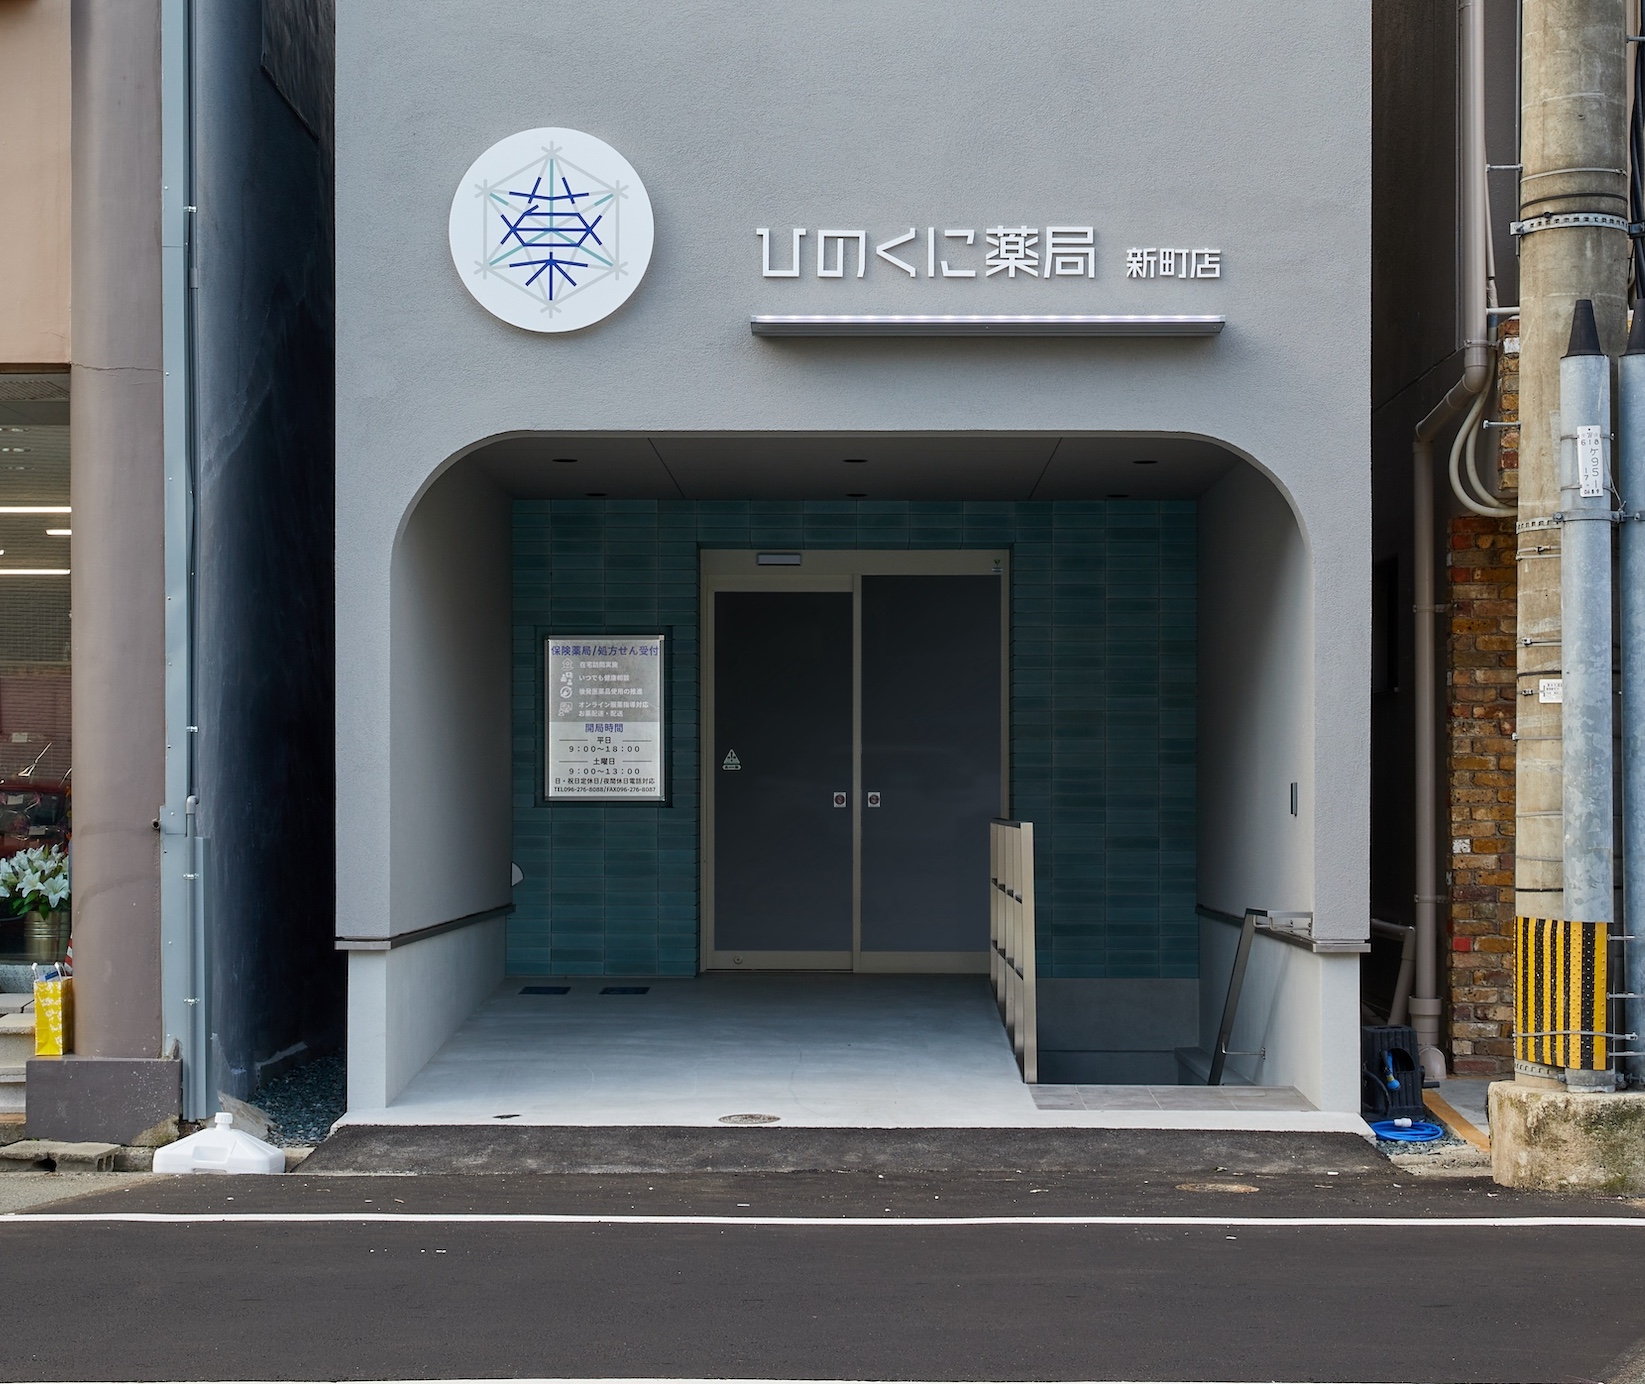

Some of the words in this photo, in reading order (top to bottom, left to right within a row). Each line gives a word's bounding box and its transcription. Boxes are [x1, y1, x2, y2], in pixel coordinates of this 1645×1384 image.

[756, 225, 1096, 279] ひのくに薬局
[1125, 247, 1222, 279] 新町店
[551, 645, 659, 656] 保険薬局/処方せん受付
[578, 674, 630, 682] いつでも健康相談
[585, 723, 624, 733] 開局時間
[596, 736, 612, 744] 平日
[592, 757, 616, 765] 土曜日
